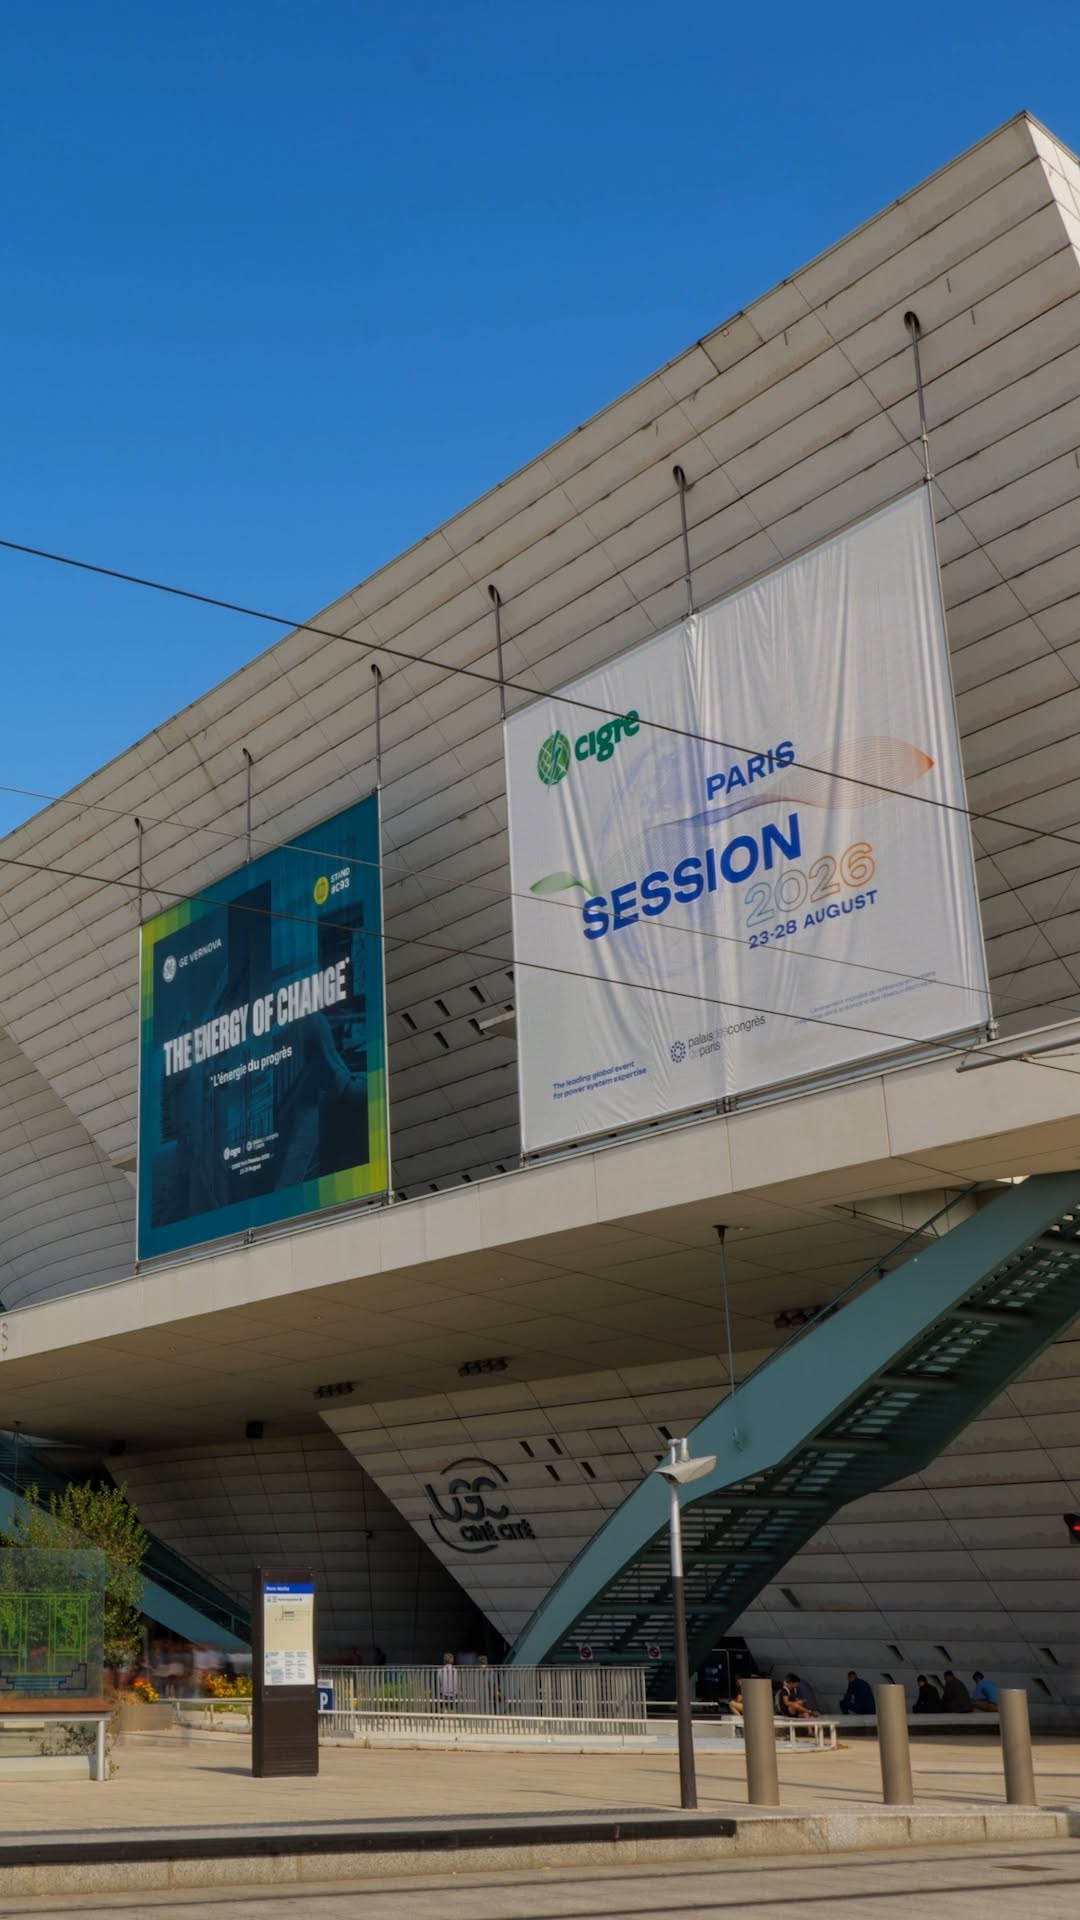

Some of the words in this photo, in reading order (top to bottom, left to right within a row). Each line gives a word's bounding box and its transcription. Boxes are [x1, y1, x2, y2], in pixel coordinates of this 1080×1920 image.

[706, 741, 796, 801] PARIS
[331, 867, 350, 883] STAND
[582, 812, 801, 940] SESSION
[744, 842, 876, 928] 2026
[748, 919, 797, 949] 23-28
[803, 889, 878, 929] AUGUST
[178, 956, 189, 968] GE
[189, 938, 222, 962] VERNOVA
[163, 1032, 193, 1077] THE
[193, 1003, 249, 1064] ENERGY
[252, 993, 274, 1037] OF
[247, 1059, 260, 1072] du
[261, 1045, 293, 1071] progrès
[553, 1082, 565, 1090] The
[566, 1075, 591, 1087] leading
[592, 1067, 614, 1080] global
[615, 1061, 635, 1073] event
[553, 1091, 563, 1100] for
[564, 1086, 585, 1098] power
[586, 1077, 613, 1091] system
[613, 1067, 647, 1083] expertise
[319, 1691, 329, 1711] P
